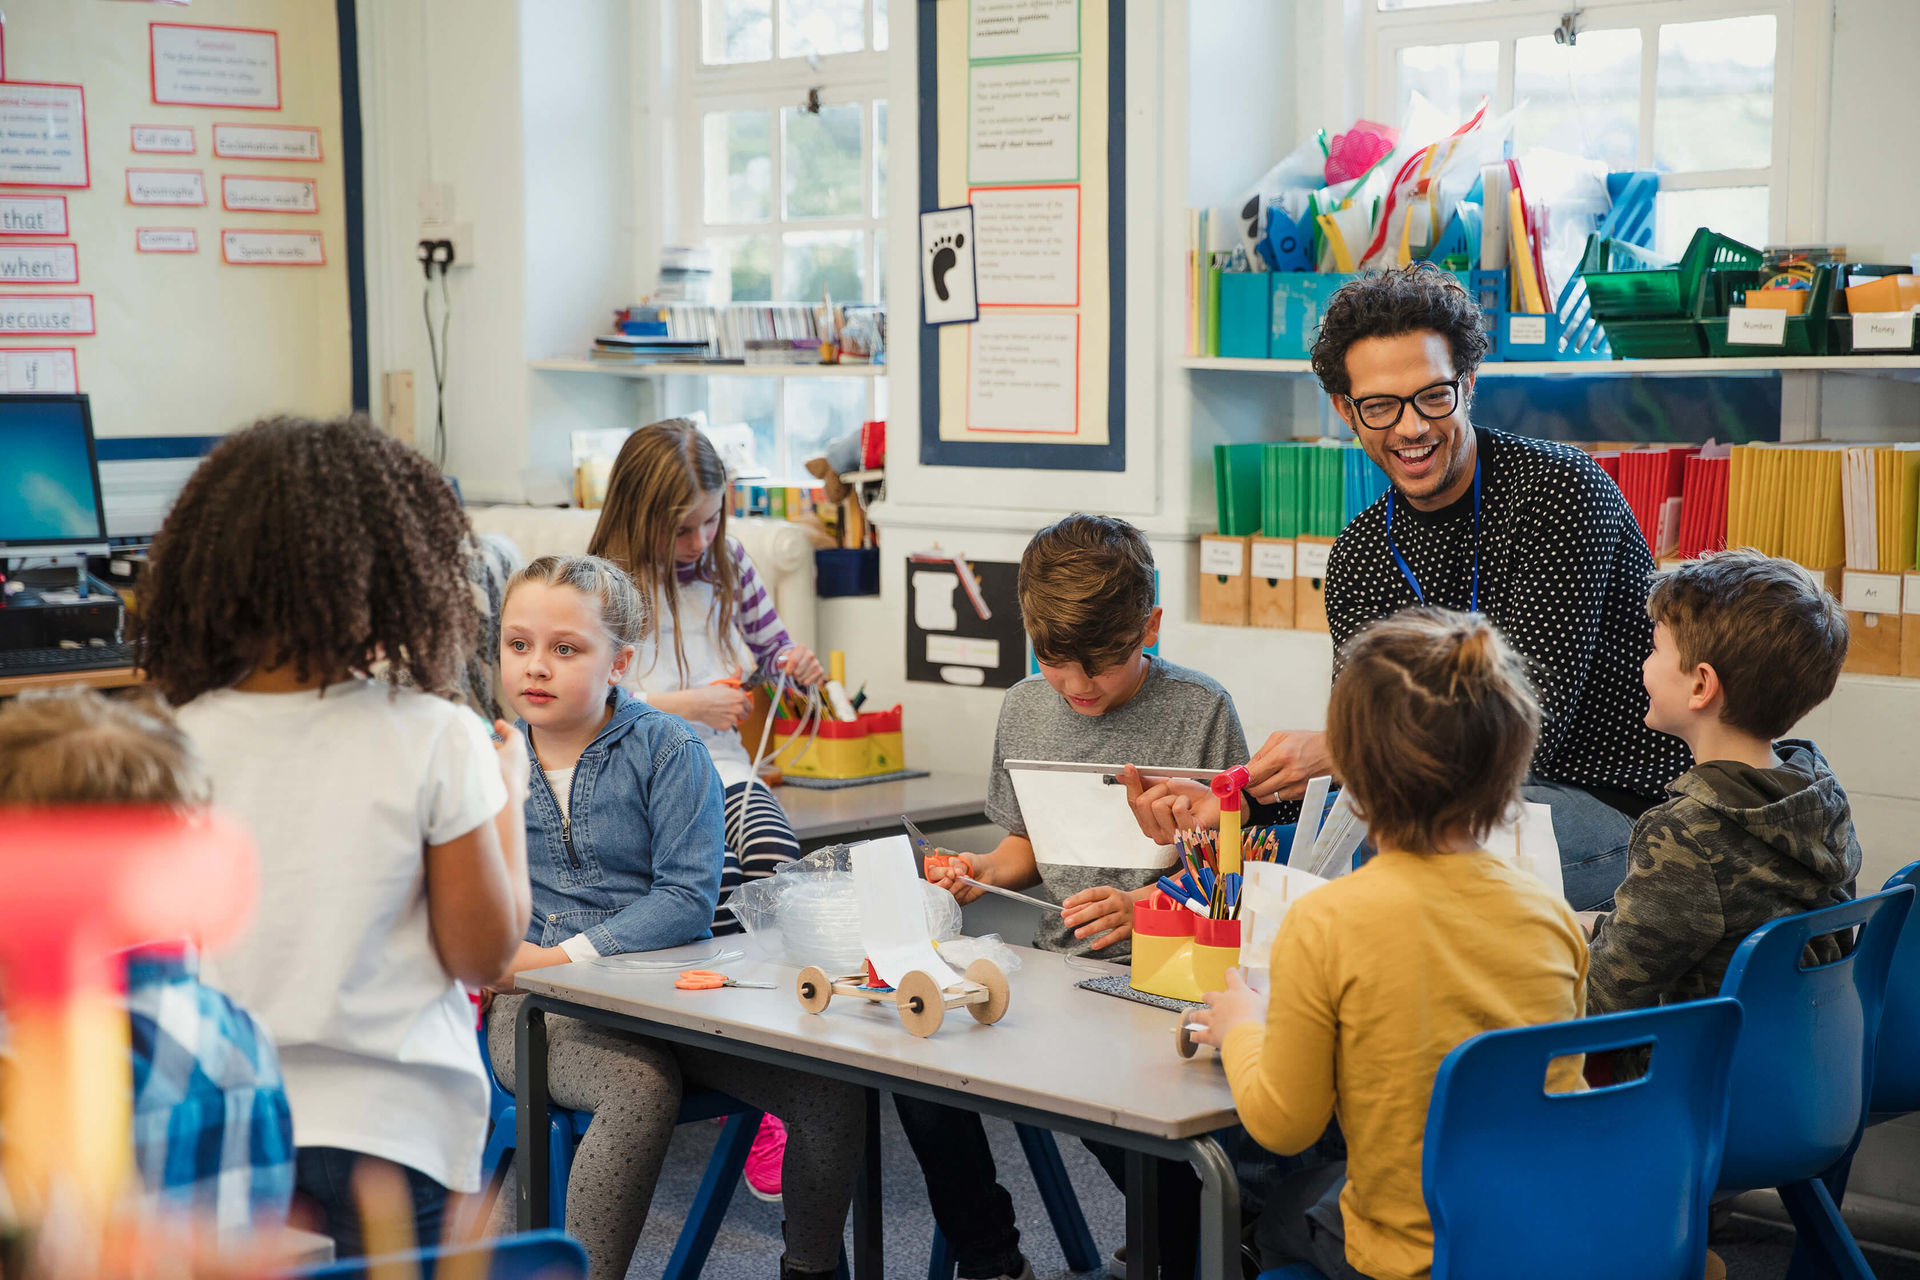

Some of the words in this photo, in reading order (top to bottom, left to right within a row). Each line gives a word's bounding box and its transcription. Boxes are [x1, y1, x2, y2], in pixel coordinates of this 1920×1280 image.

[3, 206, 45, 230] that
[0, 254, 56, 277] when
[1743, 321, 1773, 330] Numbers
[1870, 324, 1895, 336] Money
[25, 359, 39, 390] if
[1865, 588, 1878, 598] Art
